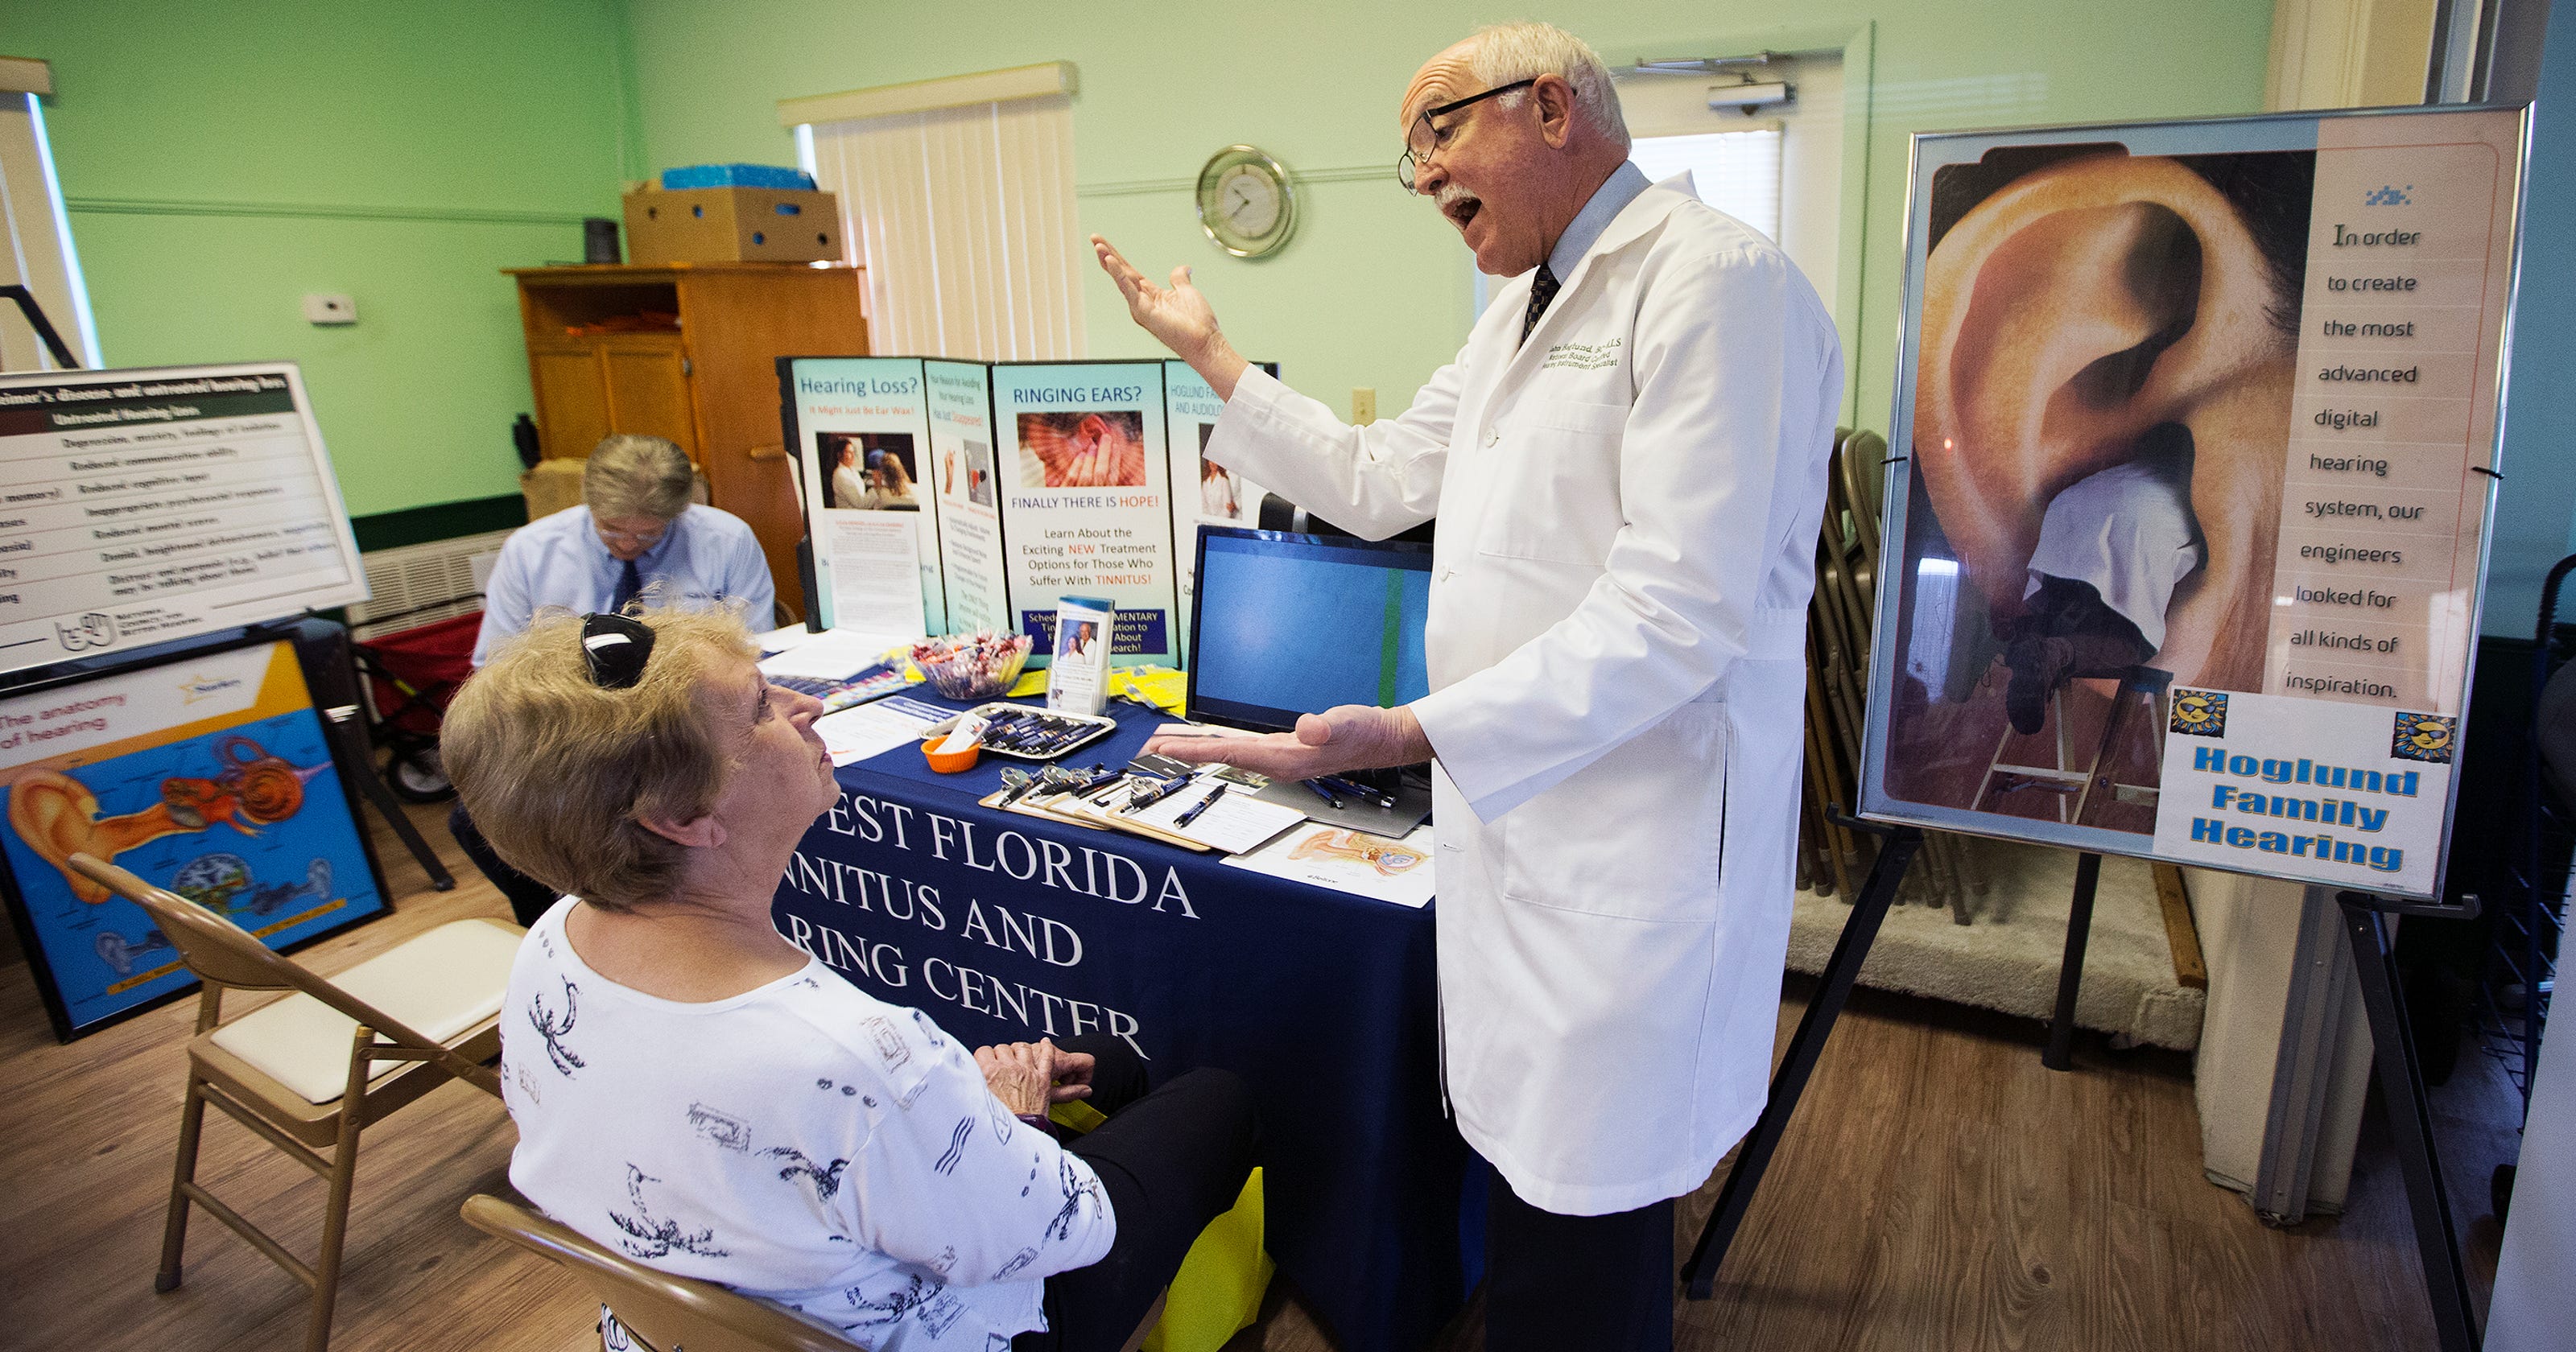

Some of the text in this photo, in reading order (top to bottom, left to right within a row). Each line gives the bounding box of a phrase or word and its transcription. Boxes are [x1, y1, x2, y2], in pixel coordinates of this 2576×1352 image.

[2333, 224, 2421, 246] In order
[2328, 275, 2417, 291] to create
[2323, 319, 2414, 337] the most
[1569, 352, 1591, 362] Board
[2318, 365, 2417, 384] advanced
[56, 387, 114, 402] disease
[113, 383, 143, 398] and
[142, 379, 210, 397] untreated
[208, 377, 261, 394] hearing
[800, 377, 919, 398] Hearing Loss?
[1013, 386, 1142, 403] RINGING EARS?
[1170, 385, 1204, 398] HOGLUND
[52, 409, 120, 425] Untreated
[818, 405, 842, 416] Might
[844, 406, 861, 414] Just
[862, 406, 873, 414] Be
[875, 406, 889, 414] Ear
[890, 406, 914, 416] Wax!
[1174, 402, 1190, 414] AND
[2314, 410, 2378, 430] digital
[2310, 452, 2388, 476] hearing
[1012, 495, 1159, 509] FINALLY THERE IS HOPE!
[2305, 498, 2425, 521] system, our
[1044, 528, 1133, 538] Learn About the
[1022, 544, 1157, 556] Exciting NEW Treatment
[2300, 543, 2402, 564] engineers
[1028, 559, 1154, 571] Options for Those Who
[1030, 575, 1152, 586] Suffer With TINNITUS!
[2296, 585, 2396, 608] looked for
[1029, 612, 1056, 623] Sched
[1114, 633, 1142, 642] About
[1137, 624, 1148, 632] to
[2290, 629, 2399, 653] all kinds of
[2286, 671, 2397, 699] inspiration.
[39, 694, 127, 720] anatomy
[1, 717, 109, 750] of hearing
[2193, 745, 2421, 798] Hoglund
[2211, 784, 2390, 833] Family
[2190, 816, 2405, 873] Hearing
[827, 792, 1201, 920] EST FLORIDA
[960, 898, 1083, 967] AND
[923, 957, 1151, 1061] CENTER
